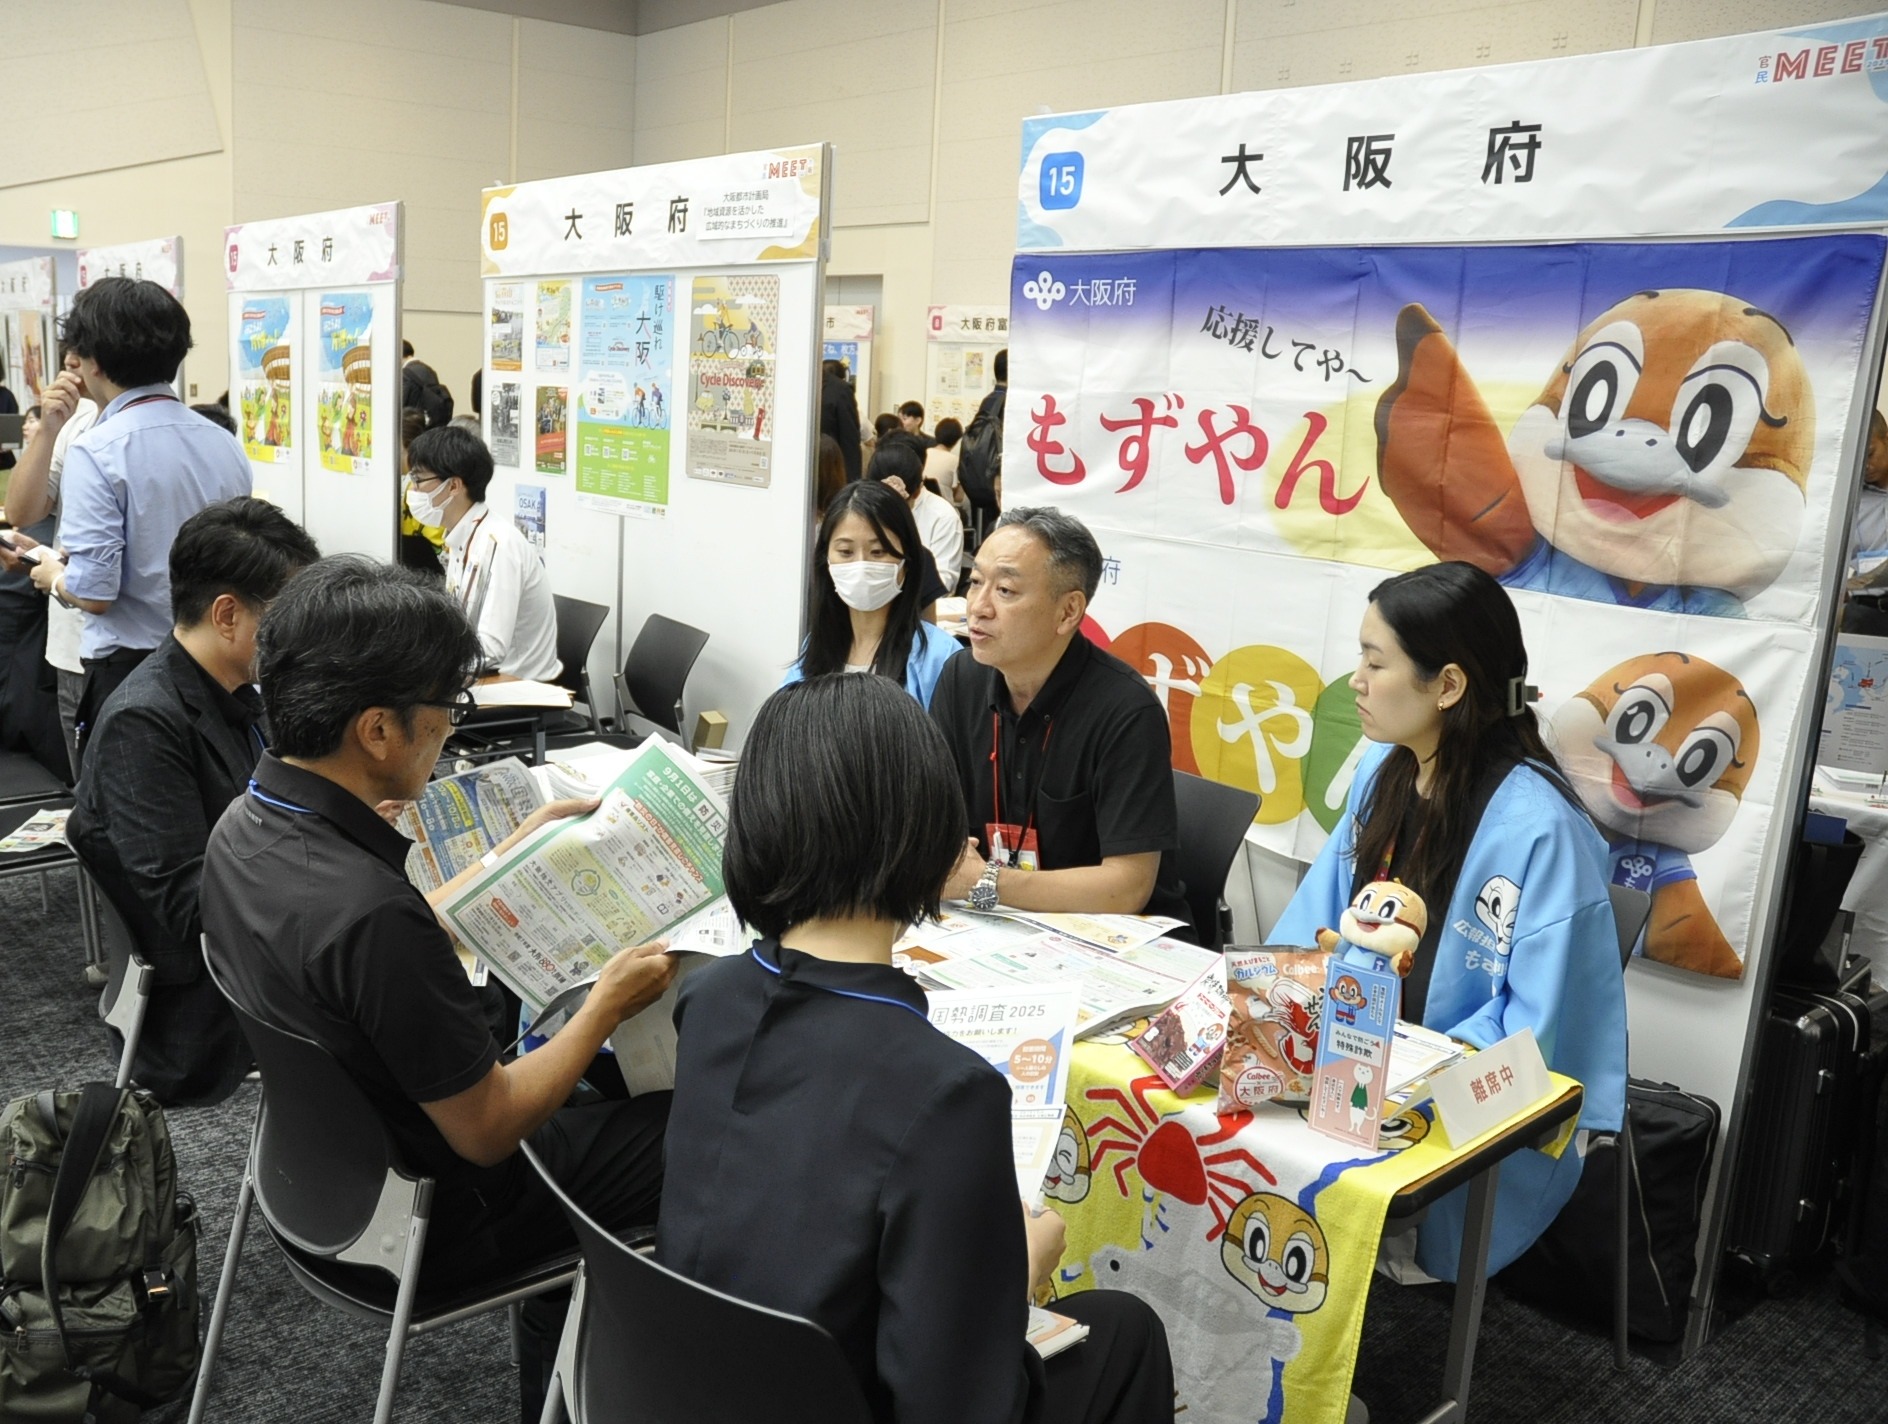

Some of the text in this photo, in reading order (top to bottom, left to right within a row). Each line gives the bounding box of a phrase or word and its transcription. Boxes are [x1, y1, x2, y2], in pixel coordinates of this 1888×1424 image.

[1772, 37, 1888, 83] MEET
[768, 159, 808, 180] MEET
[1218, 119, 1543, 196] 大阪府
[1048, 165, 1076, 197] 15
[723, 189, 769, 202] 大阪都市計画局
[564, 195, 689, 240] 大阪府
[493, 221, 506, 242] 15
[267, 236, 333, 266] 大阪府
[1068, 277, 1137, 307] 大阪府
[653, 284, 664, 350] 駆け巡れ
[635, 310, 651, 369] 大阪
[700, 372, 764, 389] Cycle Discovery
[1027, 393, 1371, 515] もずやん
[1236, 964, 1278, 980] カルシウム
[931, 1004, 1046, 1025] 国勢調査 2025
[1335, 1029, 1377, 1047] みんなで防ごう
[1336, 1040, 1373, 1060] 特殊詐欺
[1246, 1073, 1271, 1081] Calbee
[1469, 1064, 1514, 1105] 離席中
[1239, 1084, 1279, 1098] 大阪府
